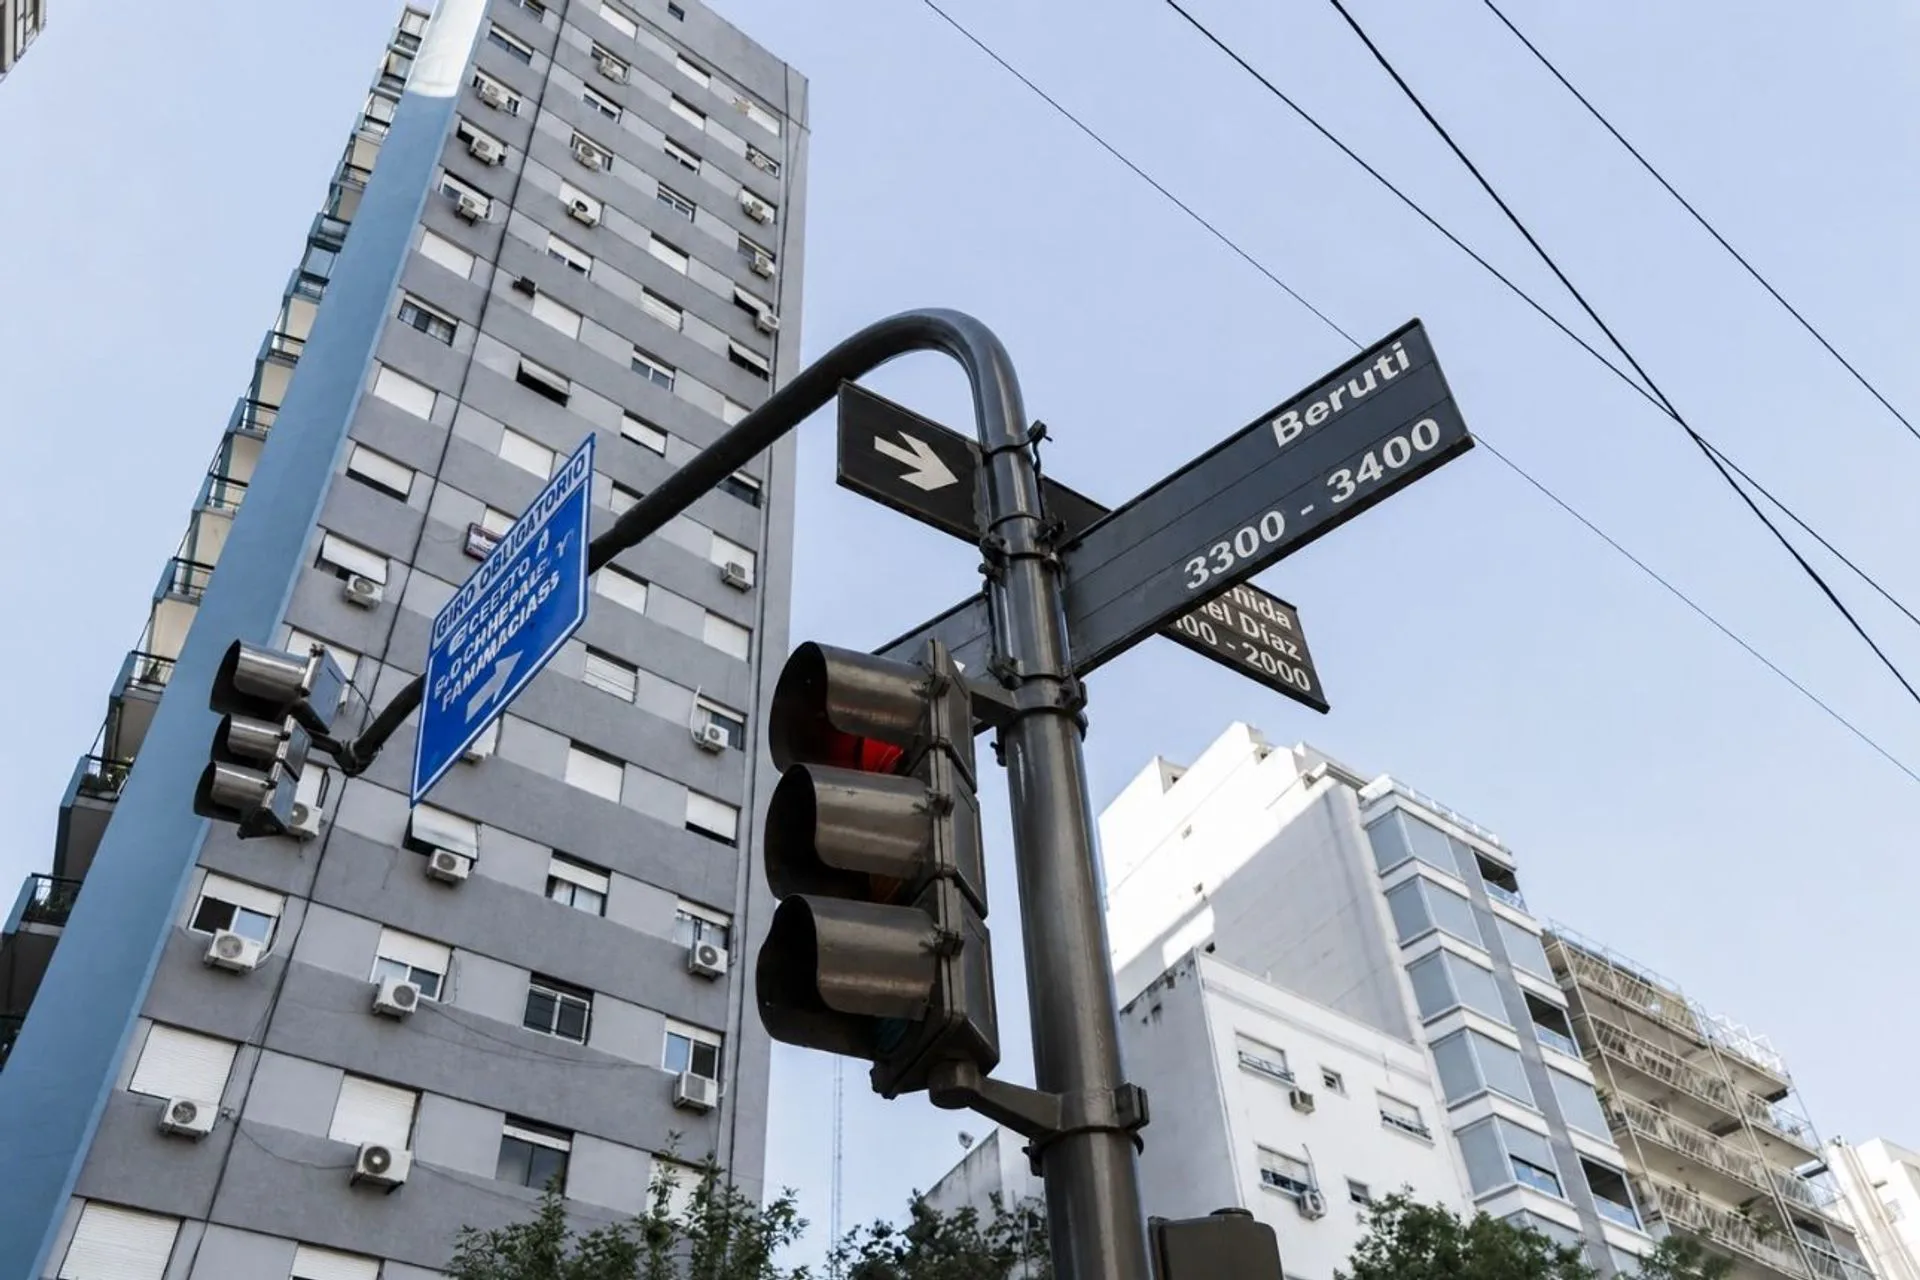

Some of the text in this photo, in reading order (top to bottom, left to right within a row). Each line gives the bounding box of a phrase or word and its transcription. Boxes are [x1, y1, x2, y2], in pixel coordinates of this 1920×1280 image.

[1271, 342, 1410, 447] Beruti
[1184, 418, 1440, 590] 3300 - 3400
[437, 585, 475, 638] GIRO
[480, 454, 586, 589] OBLIGATORIO
[1201, 604, 1233, 626] el
[1225, 587, 1291, 630] nida
[1226, 642, 1236, 651] -
[1242, 643, 1311, 692] 2000
